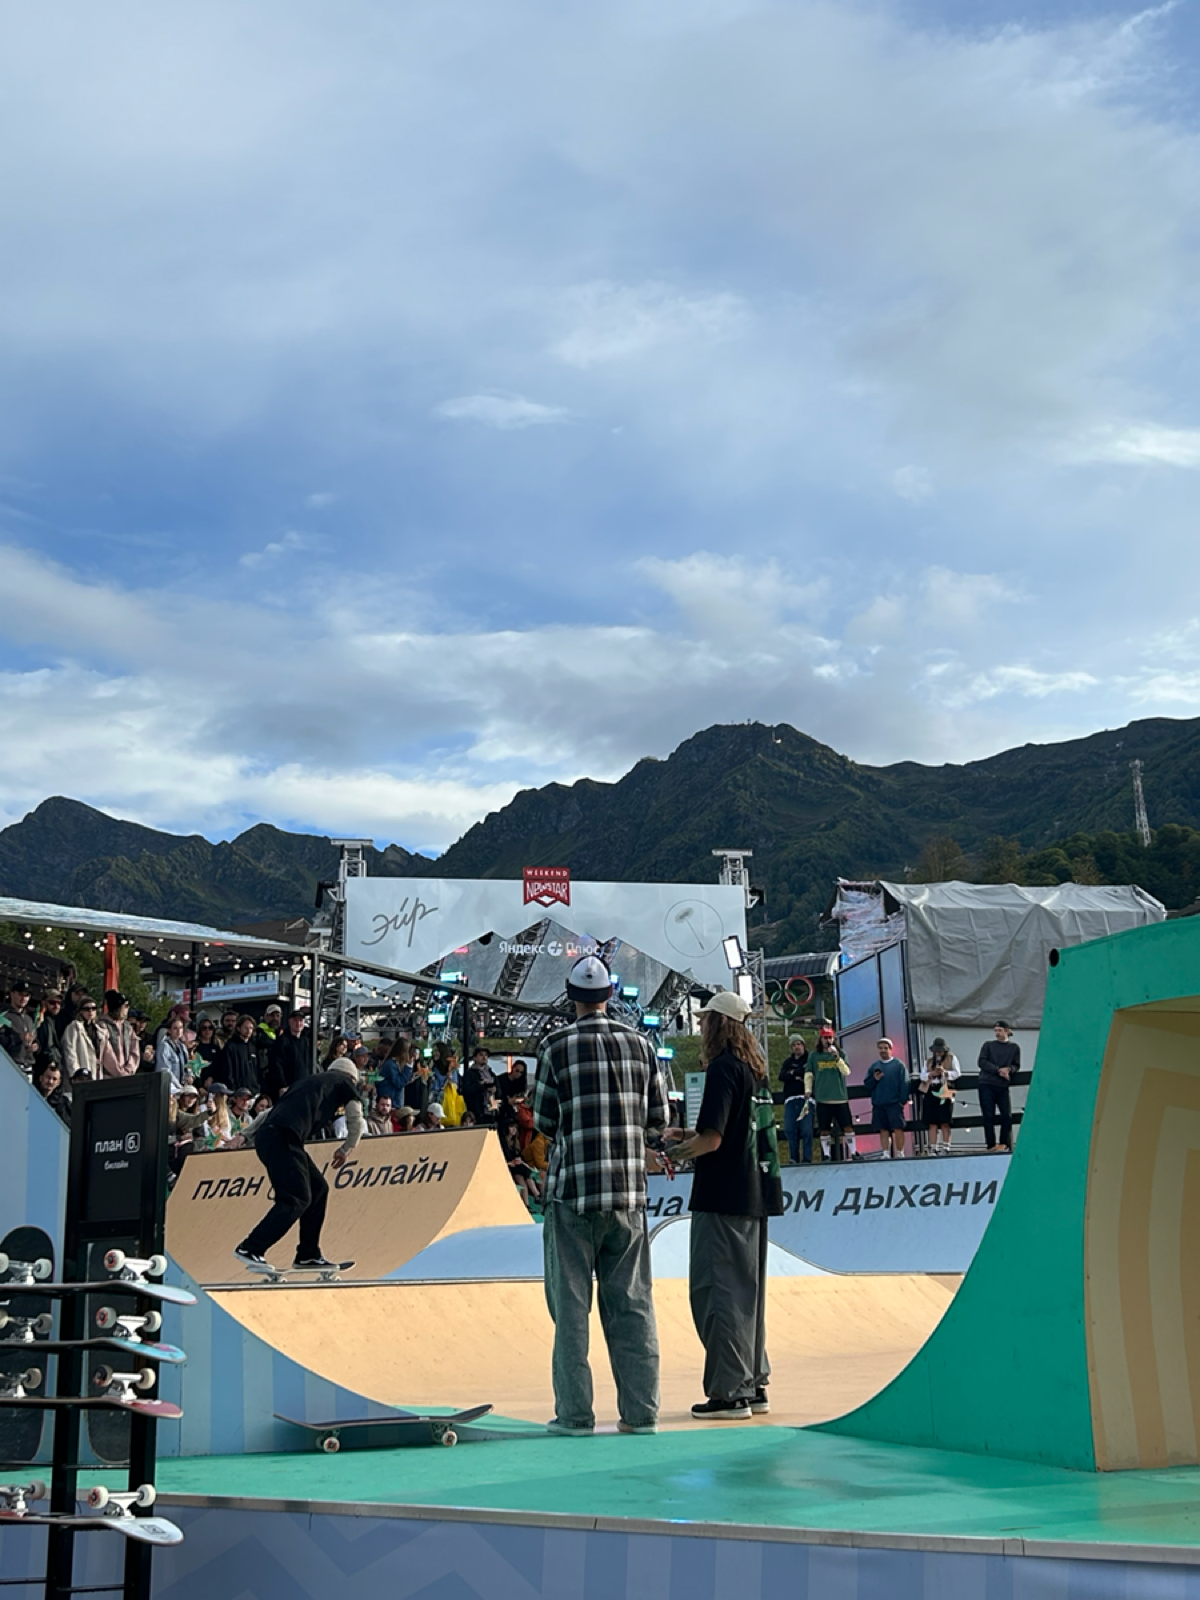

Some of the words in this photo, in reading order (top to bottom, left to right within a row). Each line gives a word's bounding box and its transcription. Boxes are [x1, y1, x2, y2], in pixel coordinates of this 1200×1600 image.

[526, 868, 568, 877] WEEKEND
[499, 941, 545, 955] Яндекс
[566, 942, 600, 955] Плюс
[94, 1139, 124, 1153] план
[191, 1176, 265, 1201] план
[334, 1156, 449, 1189] билайн
[832, 1179, 998, 1217] дыхани
